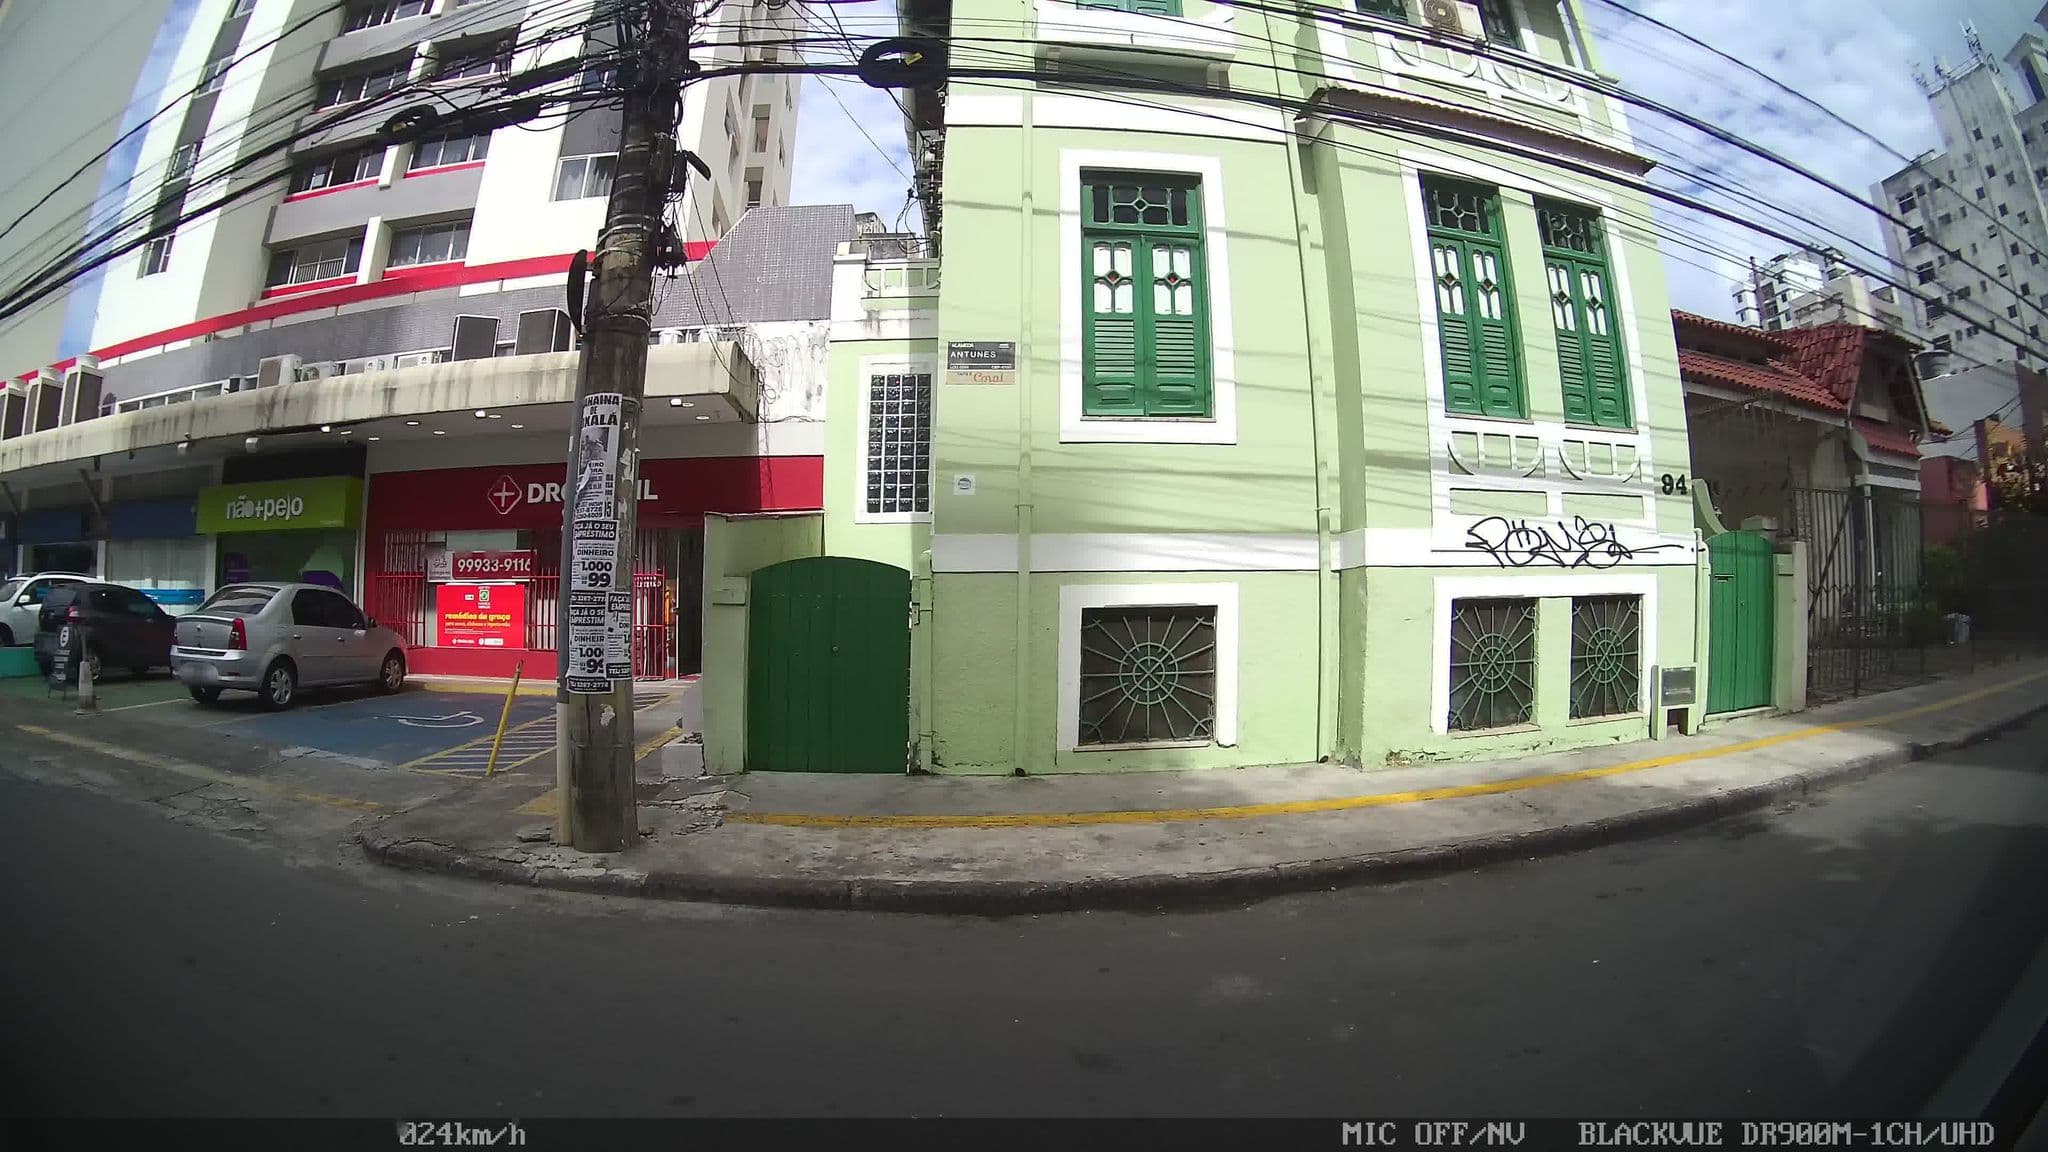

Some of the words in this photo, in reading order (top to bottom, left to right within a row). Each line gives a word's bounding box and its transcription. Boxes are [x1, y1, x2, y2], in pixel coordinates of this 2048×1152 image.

[950, 350, 997, 359] ANTUNES
[1661, 473, 1688, 496] 94
[577, 549, 615, 557] DINHEIRO
[581, 561, 613, 572] 1.000
[574, 635, 605, 643] DINHEIR
[579, 647, 604, 658] 1.00
